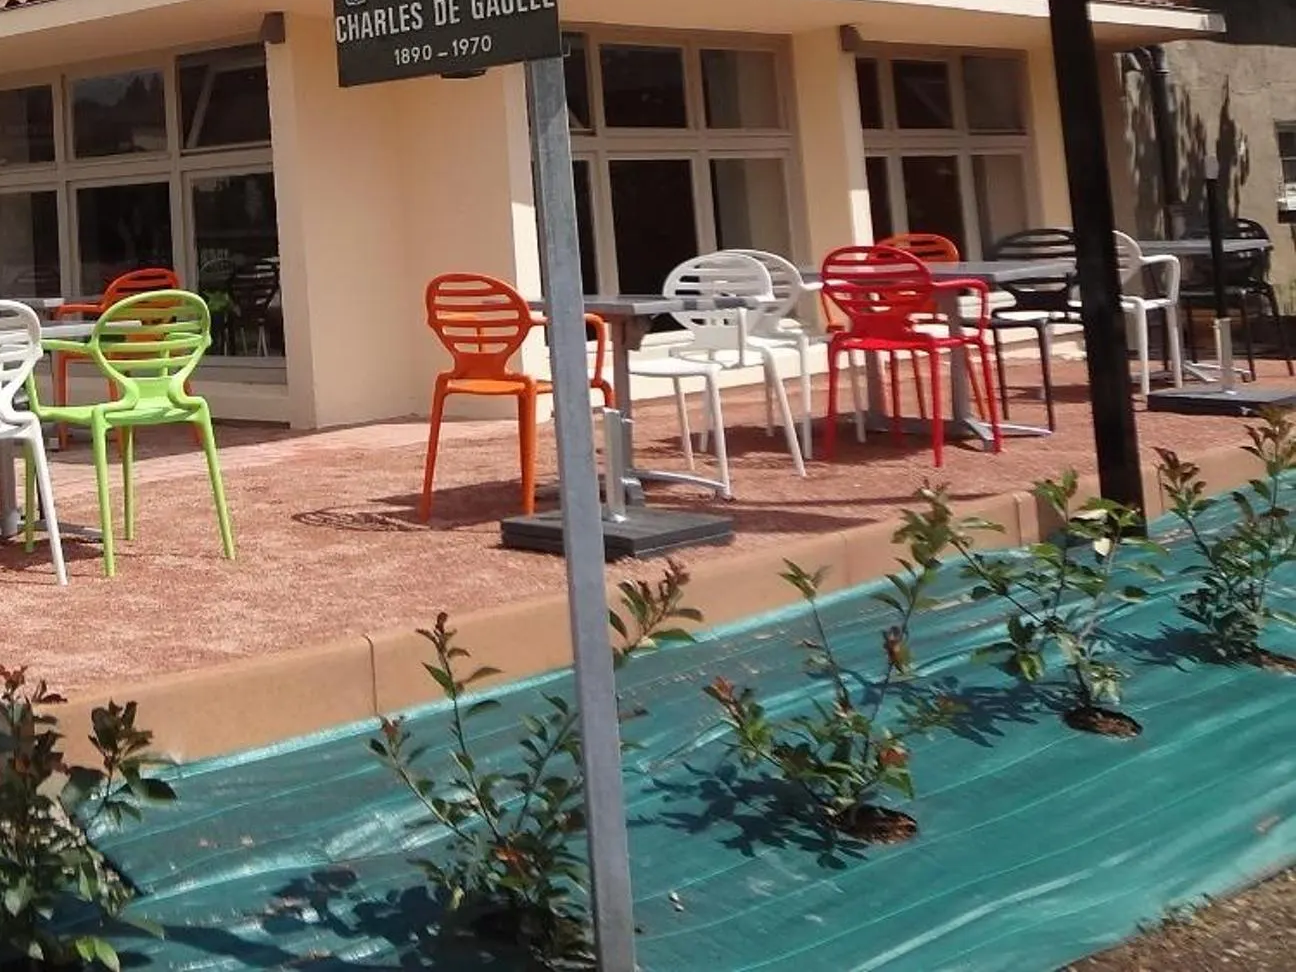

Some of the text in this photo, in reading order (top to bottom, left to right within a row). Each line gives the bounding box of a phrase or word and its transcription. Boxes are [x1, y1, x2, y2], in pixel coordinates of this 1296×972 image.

[335, 2, 424, 44] CHARLES
[393, 46, 433, 67] 1890
[451, 34, 493, 58] 1970
